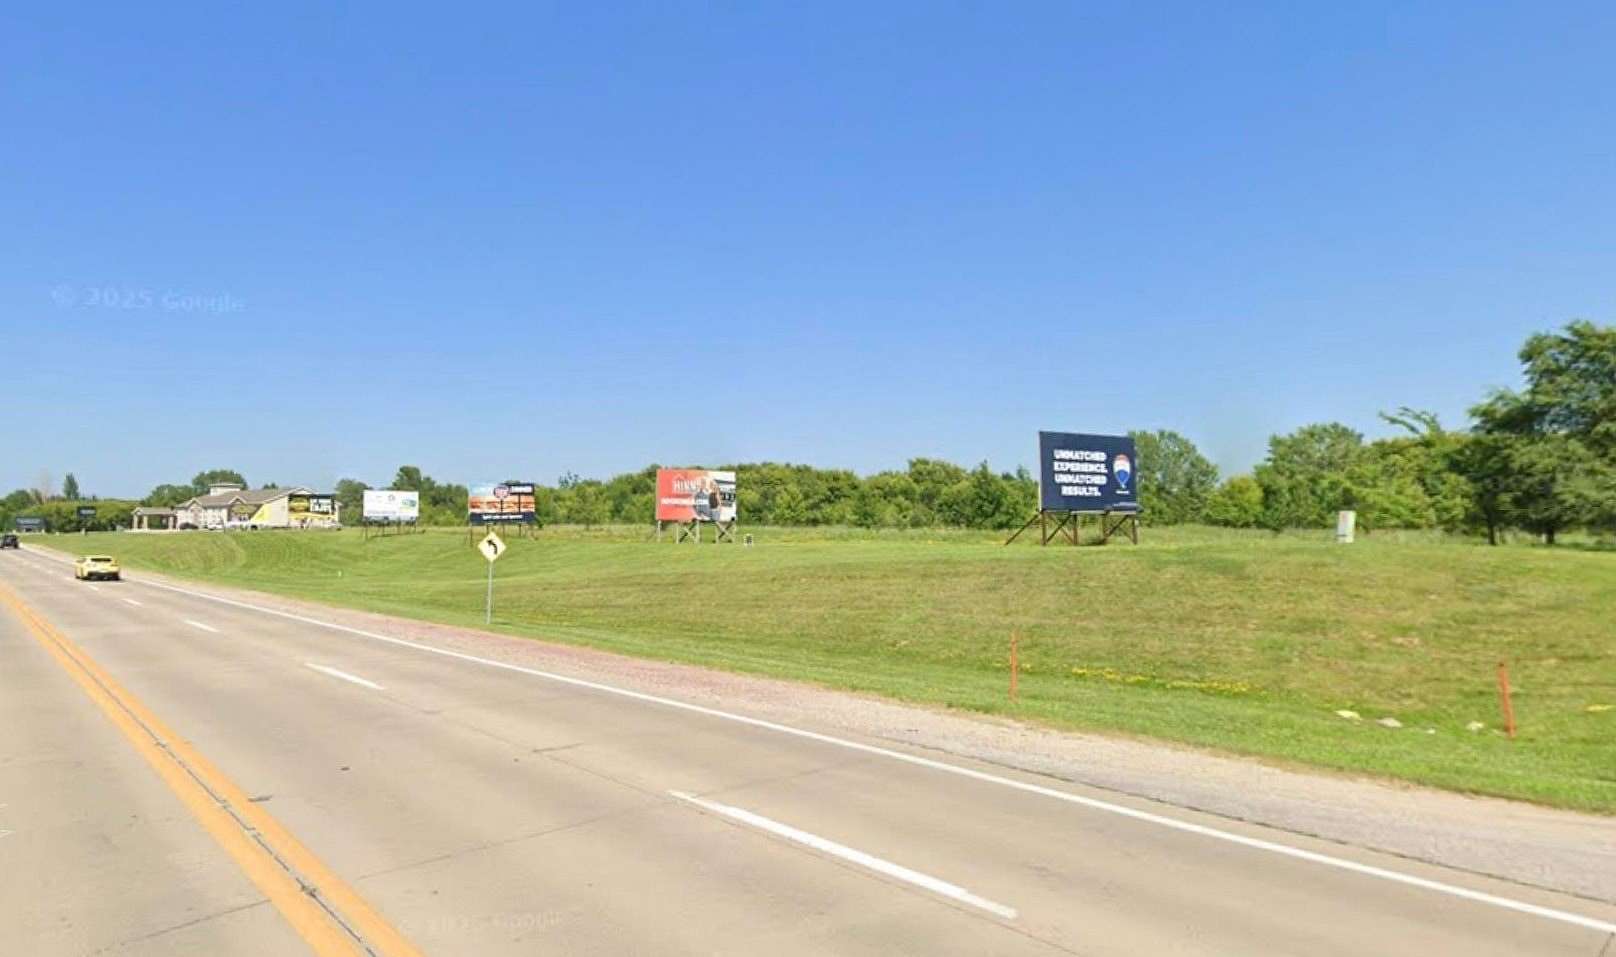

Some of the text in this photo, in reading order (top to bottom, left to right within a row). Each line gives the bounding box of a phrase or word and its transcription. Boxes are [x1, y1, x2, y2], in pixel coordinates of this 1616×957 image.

[1053, 450, 1106, 461] UNMATCHED
[1053, 461, 1108, 473] EXPERIENCE.
[1054, 473, 1107, 485] UNMATCHED
[1061, 486, 1101, 496] RESULTS.
